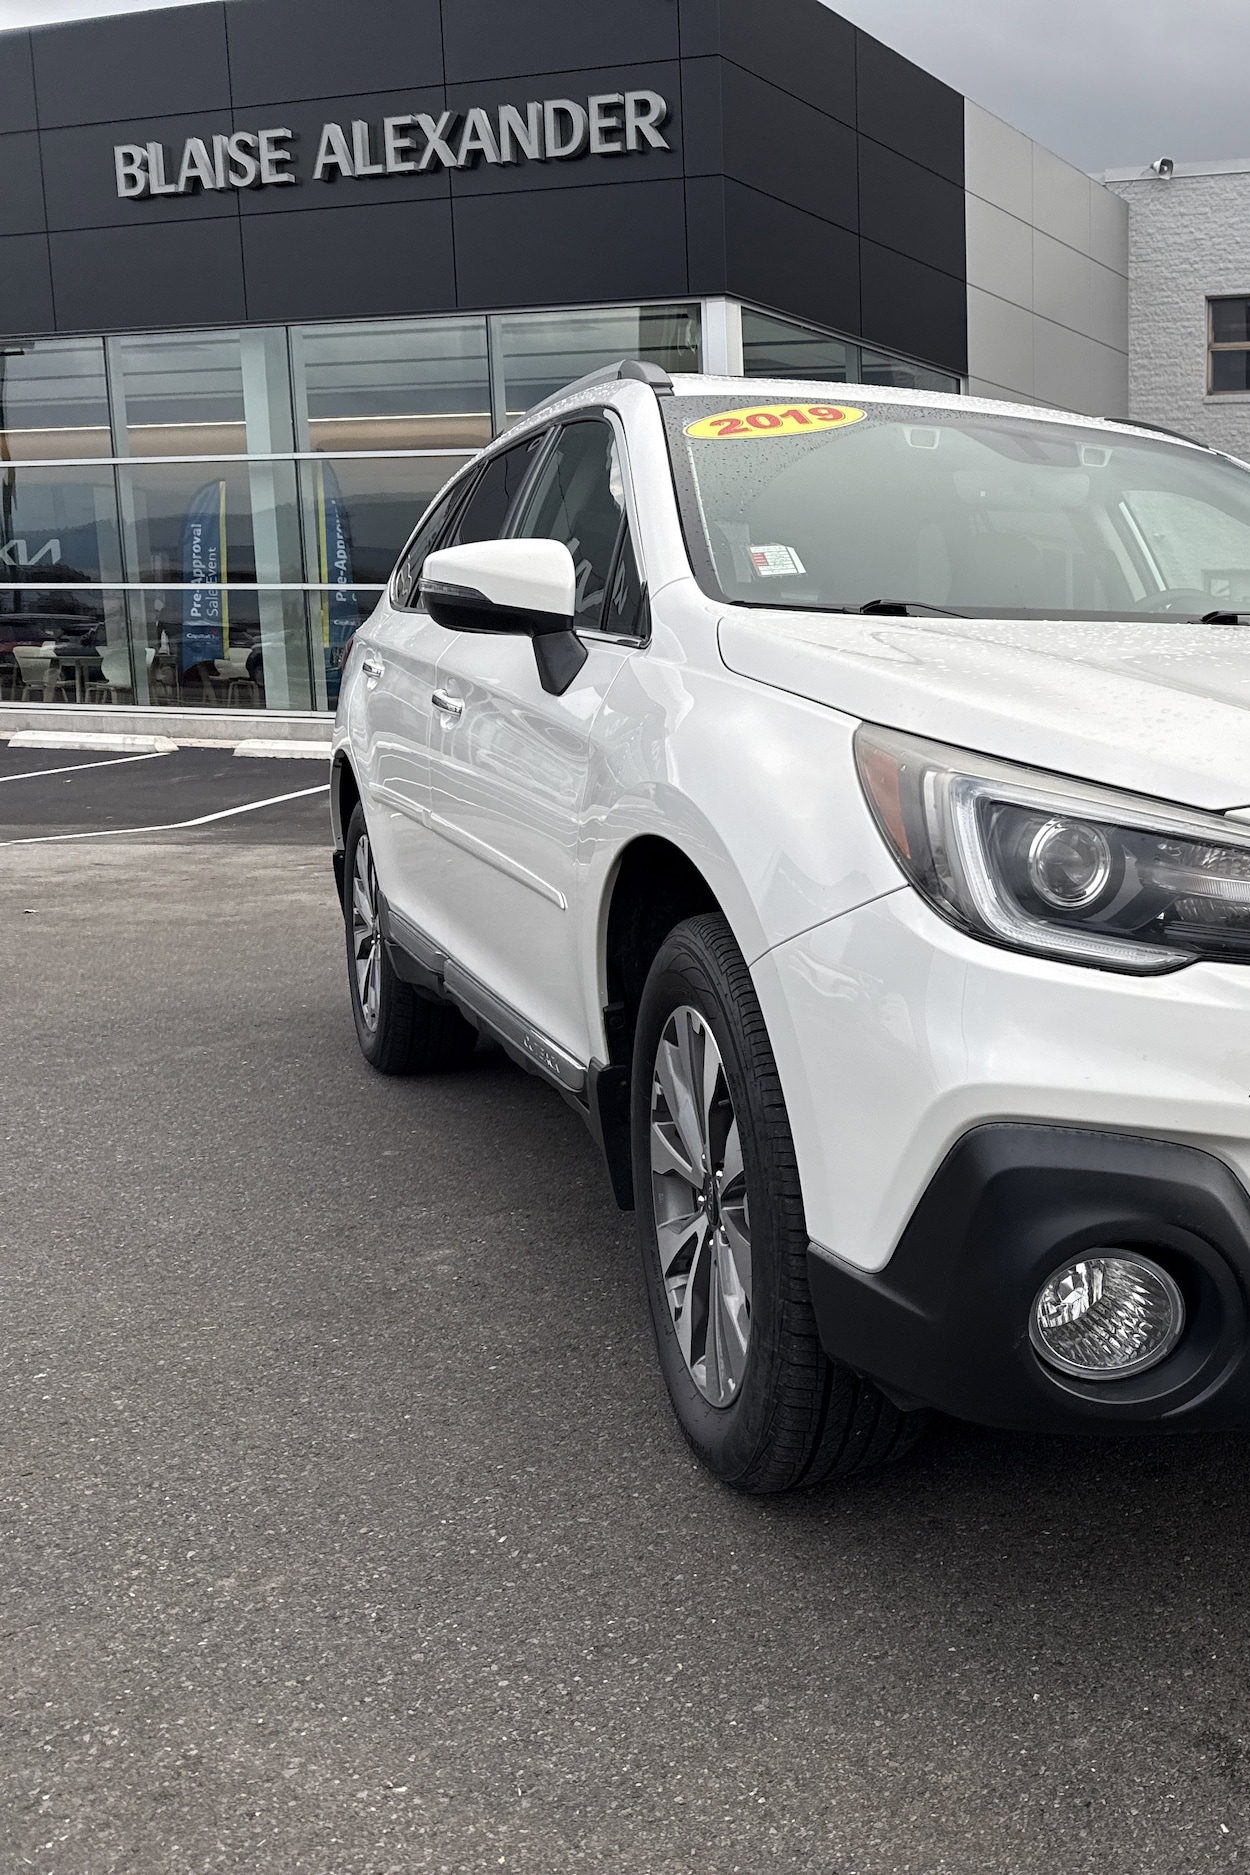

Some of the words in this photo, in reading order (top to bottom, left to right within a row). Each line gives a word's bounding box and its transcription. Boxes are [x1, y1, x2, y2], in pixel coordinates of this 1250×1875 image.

[114, 127, 296, 198] BLAISE
[312, 89, 671, 180] ALEXANDER
[709, 406, 846, 436] 2019
[190, 523, 206, 617] Pre-Approval
[206, 547, 218, 585] Event
